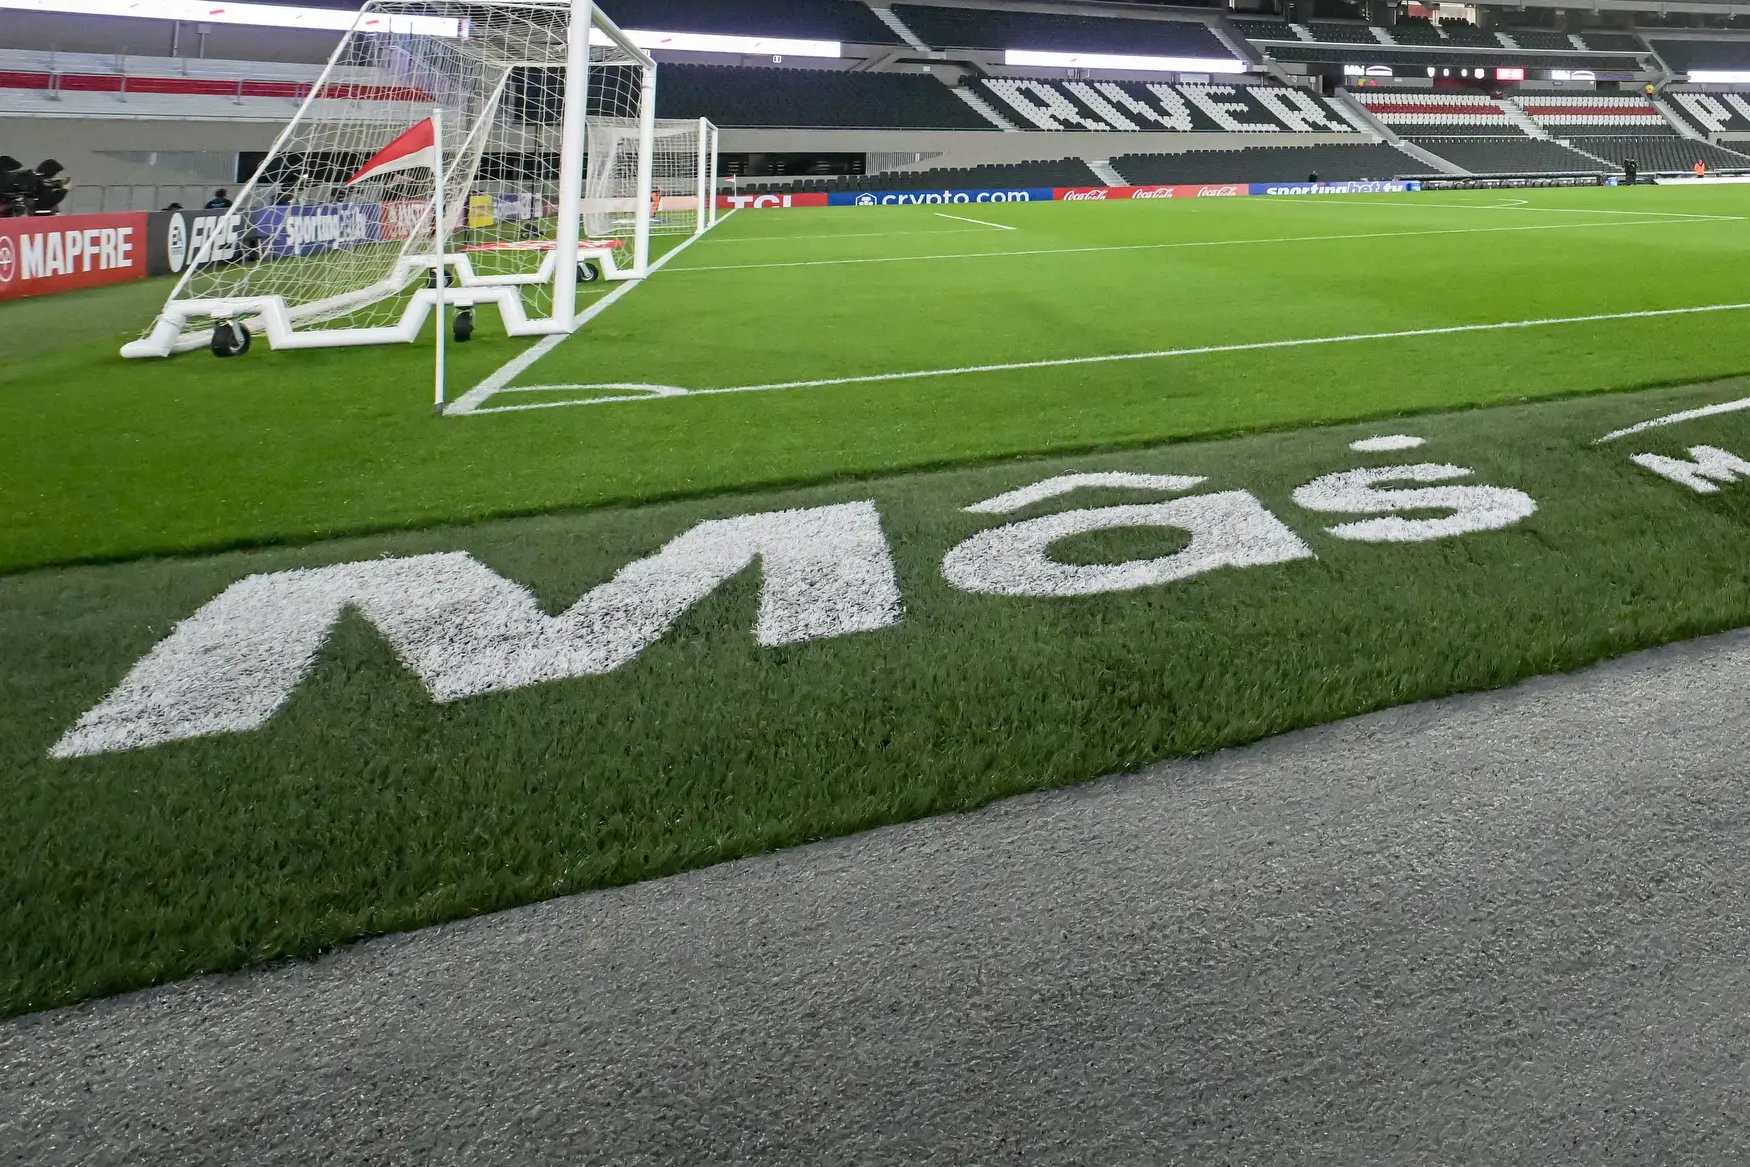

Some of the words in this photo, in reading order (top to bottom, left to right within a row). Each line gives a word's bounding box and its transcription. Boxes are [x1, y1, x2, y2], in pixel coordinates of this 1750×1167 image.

[980, 79, 1362, 133] RIVER
[882, 189, 1030, 205] cryptocom
[1266, 181, 1403, 195] sportingbettv
[20, 227, 133, 280] MAPFRE
